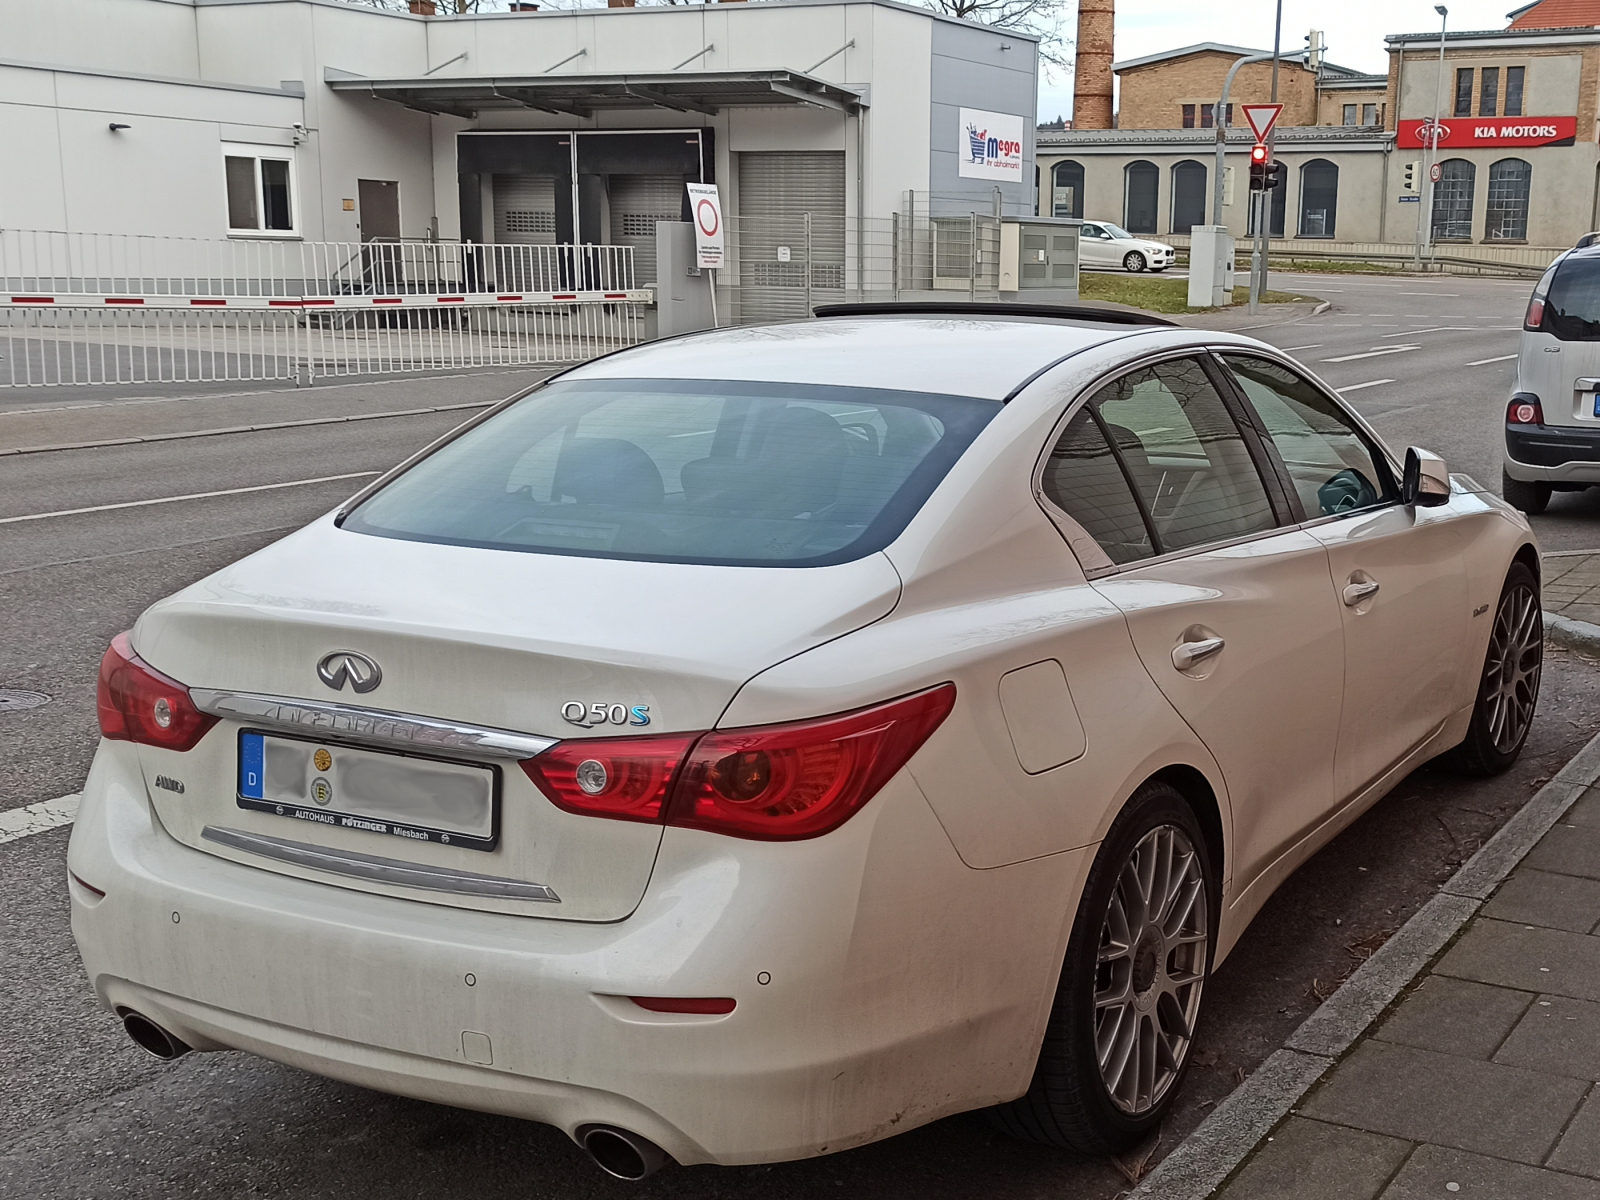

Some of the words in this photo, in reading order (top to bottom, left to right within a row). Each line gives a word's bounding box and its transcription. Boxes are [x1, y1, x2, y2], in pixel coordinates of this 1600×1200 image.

[1474, 126, 1496, 138] KIA
[1500, 125, 1557, 138] MOTORS
[560, 700, 651, 729] Q50S
[247, 771, 257, 786] D
[295, 809, 335, 824] AUTOHAUS
[393, 826, 429, 841] Miesbach
